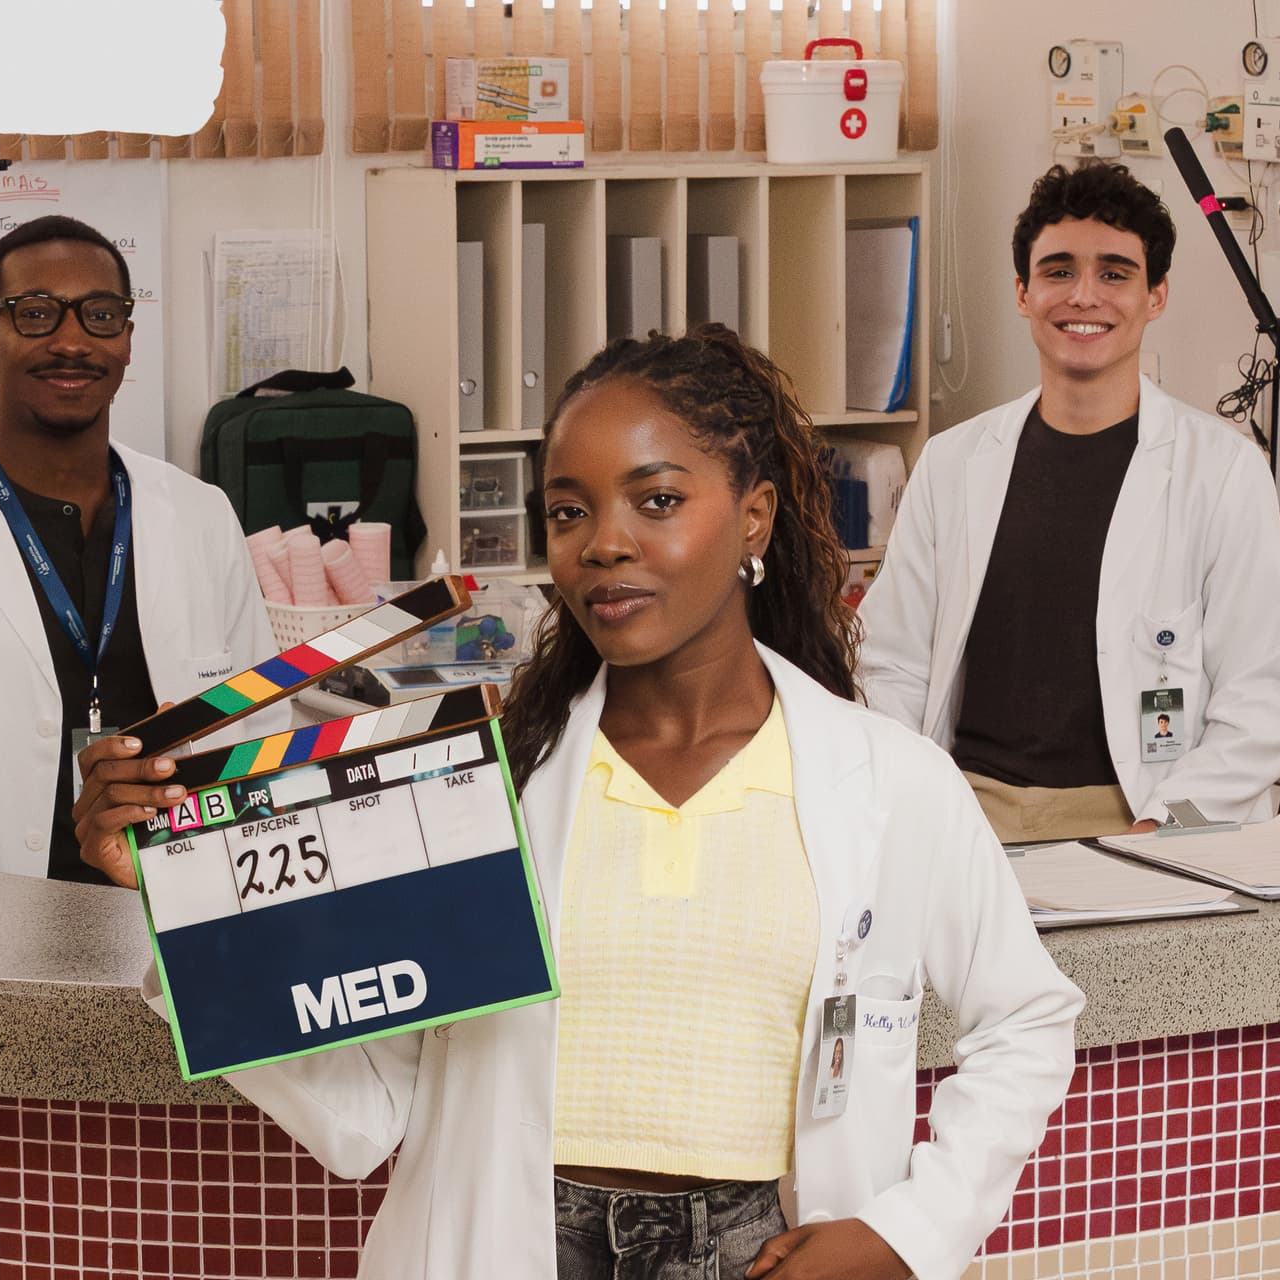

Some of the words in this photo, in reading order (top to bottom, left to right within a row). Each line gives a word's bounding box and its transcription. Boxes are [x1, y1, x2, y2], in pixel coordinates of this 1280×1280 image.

[346, 763, 376, 784] DATA
[444, 772, 475, 788] TAKE
[248, 789, 269, 807] FPS
[349, 794, 381, 811] SHOT
[147, 815, 171, 832] CAM
[177, 800, 196, 826] A
[205, 794, 225, 819] B
[241, 815, 300, 838] EP/SCENE
[166, 841, 195, 856] ROLL
[236, 835, 329, 899] 2.25
[290, 959, 428, 1034] MED
